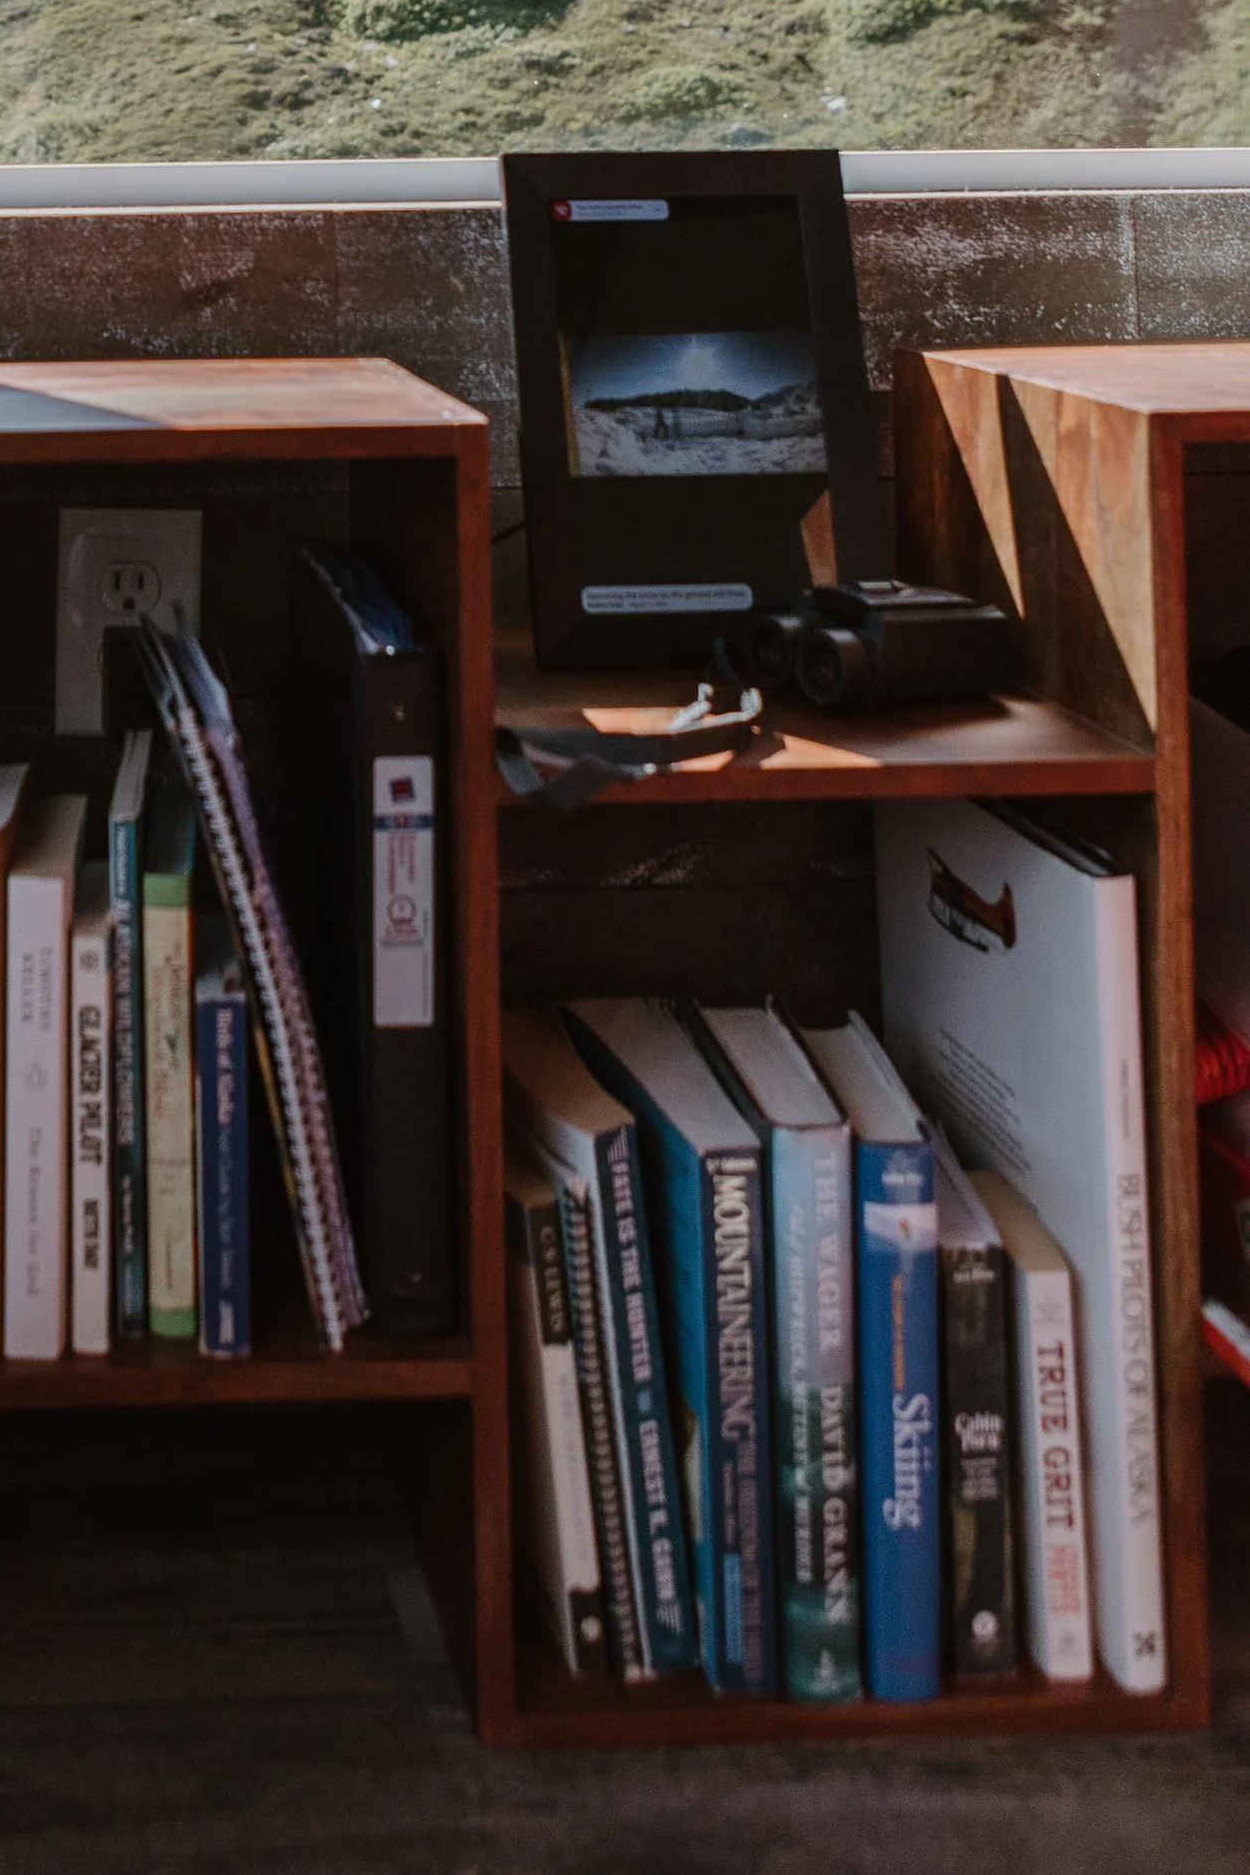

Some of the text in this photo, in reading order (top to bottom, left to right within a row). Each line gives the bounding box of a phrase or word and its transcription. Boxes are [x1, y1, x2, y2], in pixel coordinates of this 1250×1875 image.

[78, 1004, 103, 1165] GLACIER PILOT
[114, 997, 135, 1145] WILDFLOWERS
[610, 1160, 635, 1215] FATE
[617, 1215, 638, 1244] IS
[544, 1266, 567, 1334] LEWIS
[620, 1244, 643, 1291] THE
[713, 1174, 756, 1442] MOUNTAINEERING
[817, 1233, 843, 1353] WAGER
[625, 1291, 654, 1383] HUNTER
[1037, 1338, 1066, 1433] TRUE
[1116, 1171, 1156, 1529] BUSH PILOTS OF ALASKA
[639, 1418, 667, 1505] ERNEST
[819, 1382, 856, 1492] DAVID
[881, 1391, 932, 1529] Skiing
[1042, 1445, 1074, 1529] GRIT
[823, 1495, 852, 1625] GRANN
